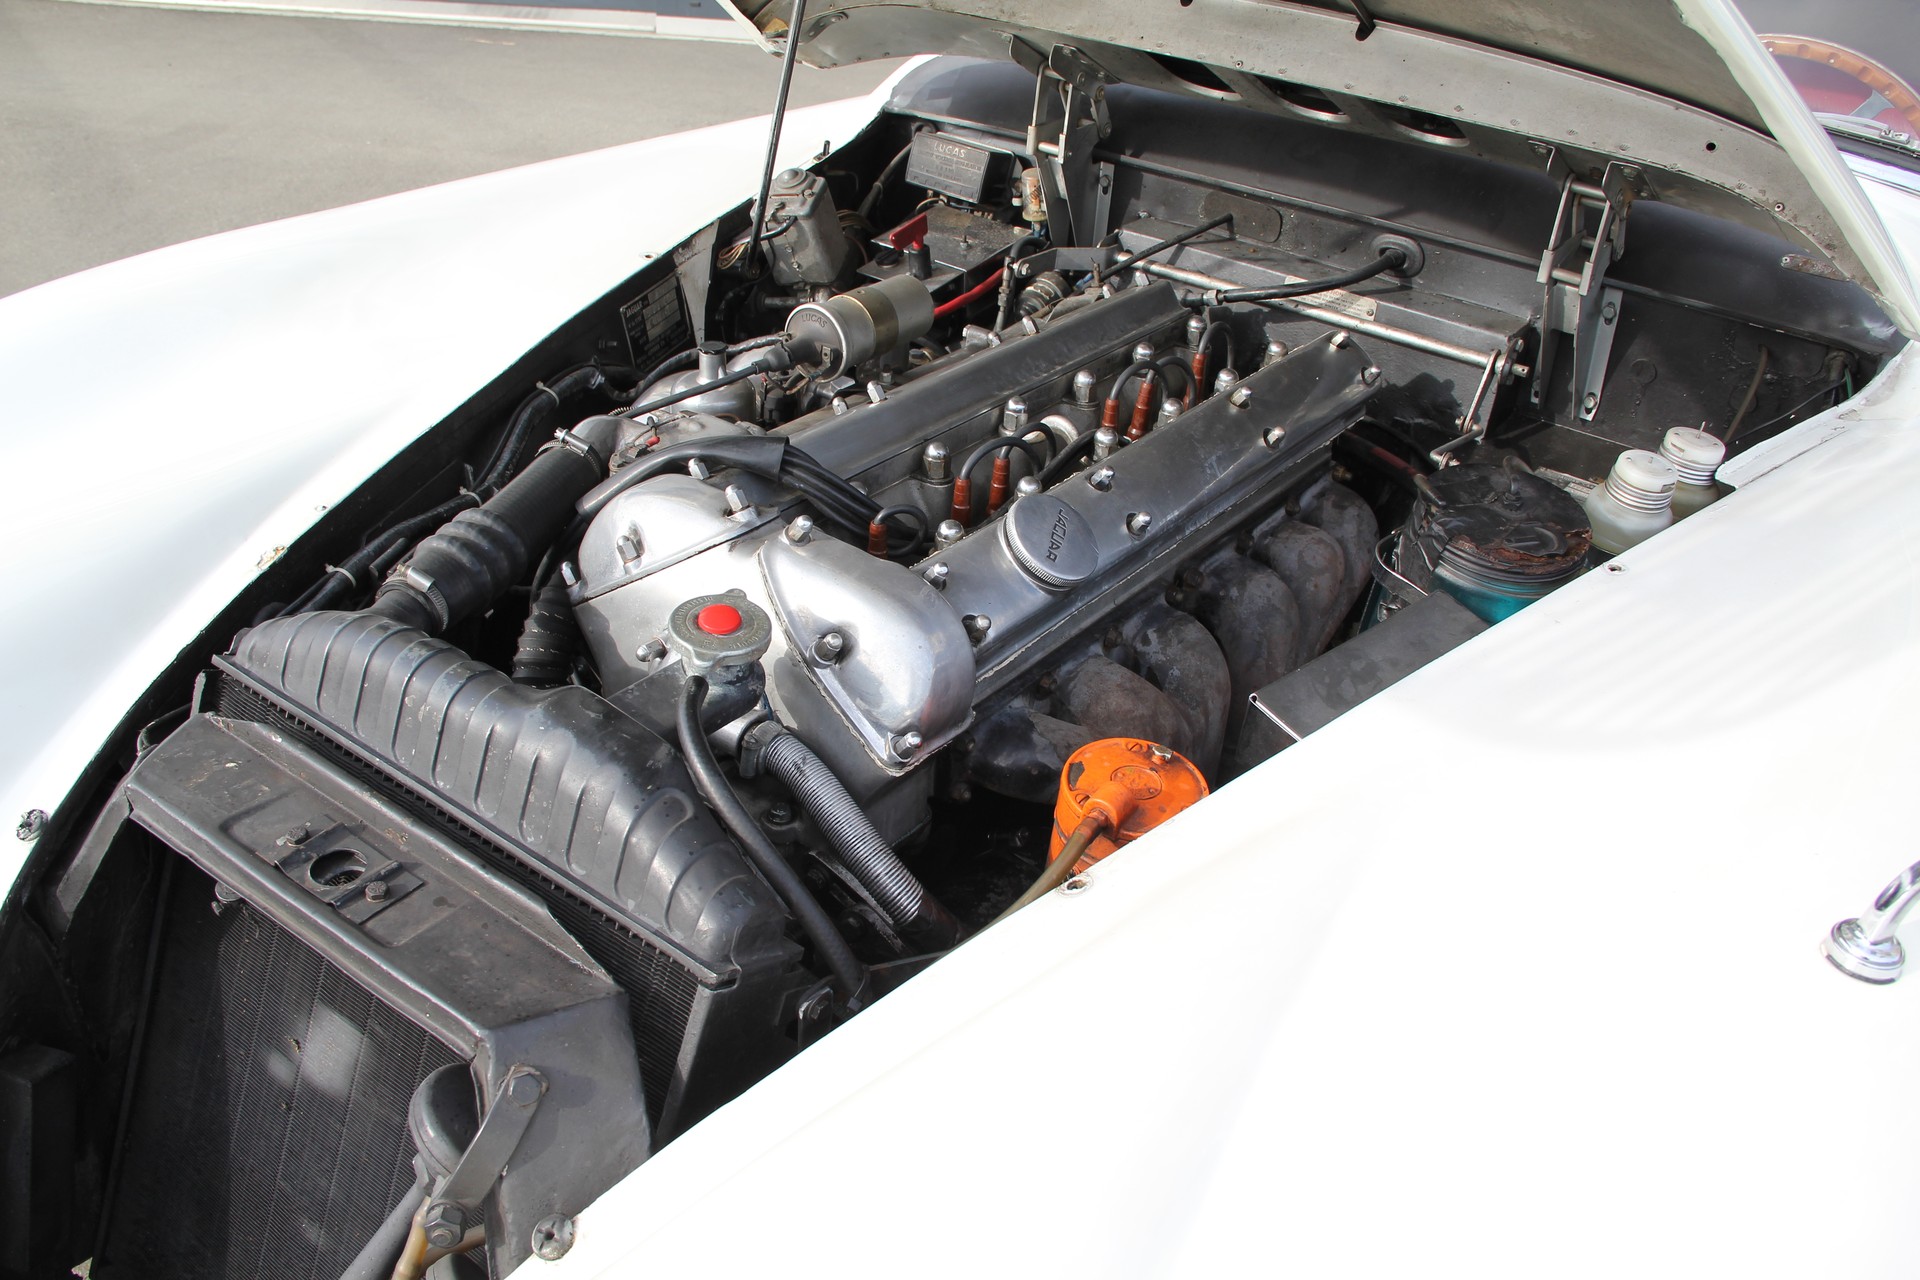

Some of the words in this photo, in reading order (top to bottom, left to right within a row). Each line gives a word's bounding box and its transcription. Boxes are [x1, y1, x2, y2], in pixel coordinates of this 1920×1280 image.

[934, 140, 967, 158] LUCAS
[801, 313, 828, 328] LUCAS
[1046, 507, 1070, 563] JAGUAR
